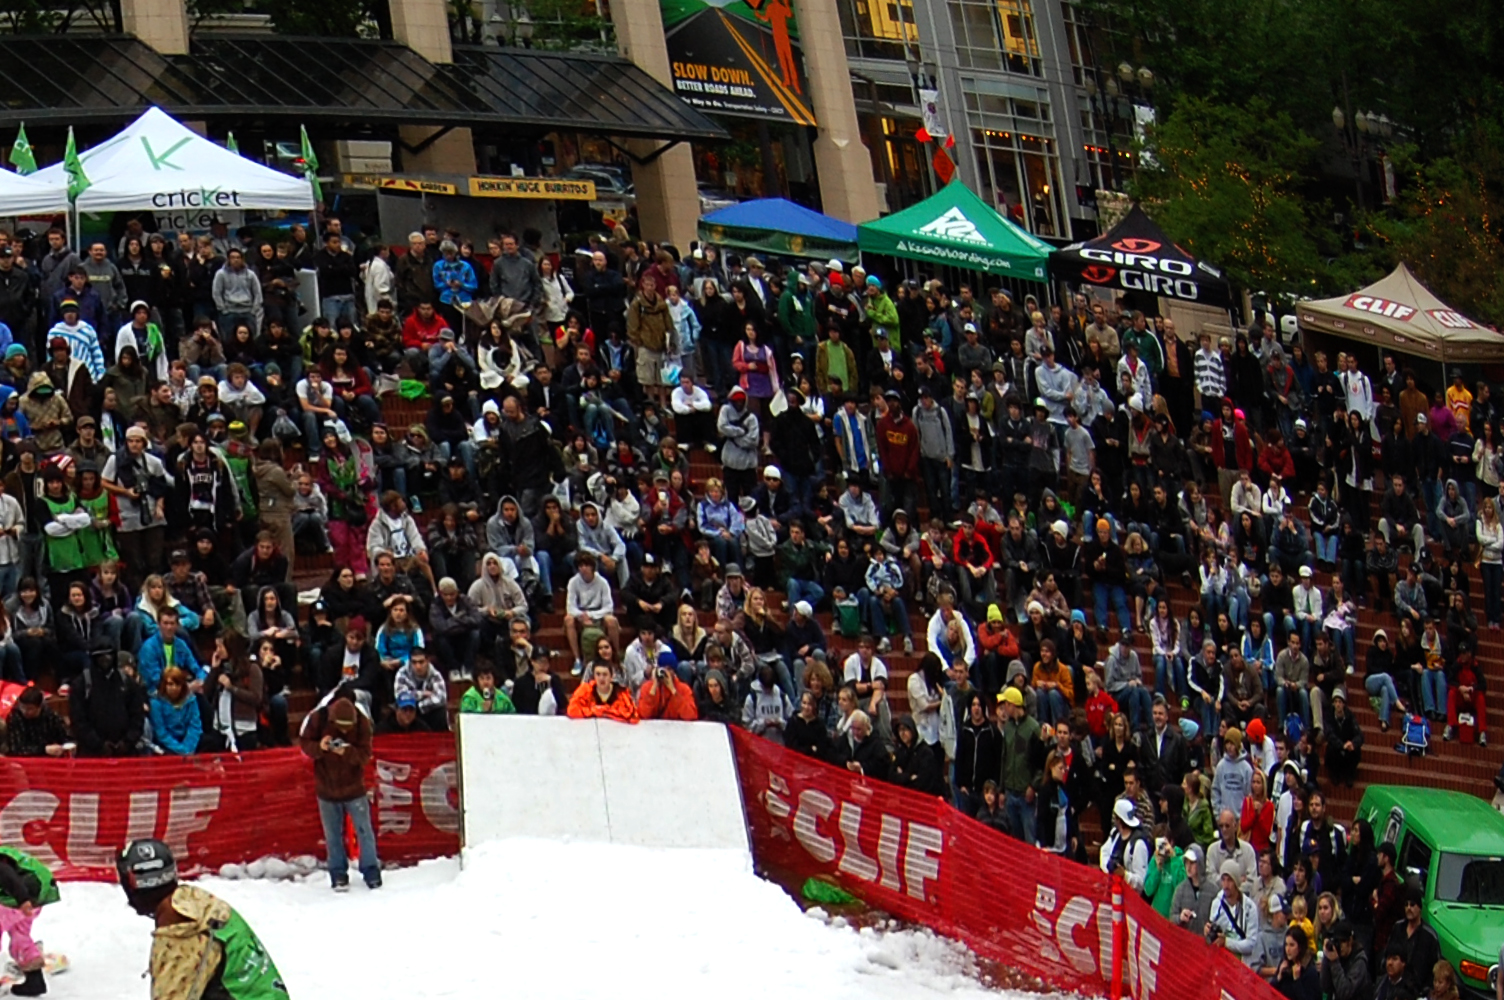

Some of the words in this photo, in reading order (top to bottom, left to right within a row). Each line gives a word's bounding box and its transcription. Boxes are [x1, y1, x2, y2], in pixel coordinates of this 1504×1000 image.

[673, 62, 707, 80] SLOW
[711, 66, 754, 86] DOWN.
[676, 80, 703, 92] BETTER
[704, 83, 728, 95] ROADS
[730, 86, 756, 98] AHEAD.
[515, 181, 540, 194] HUGE
[544, 182, 588, 195] BURRITOS
[157, 210, 223, 231] ricke
[1079, 248, 1193, 276] GIRO
[1119, 269, 1198, 300] GIRO
[1352, 296, 1414, 322] CLIF
[376, 759, 413, 837] BAR
[793, 789, 943, 902] CLIF
